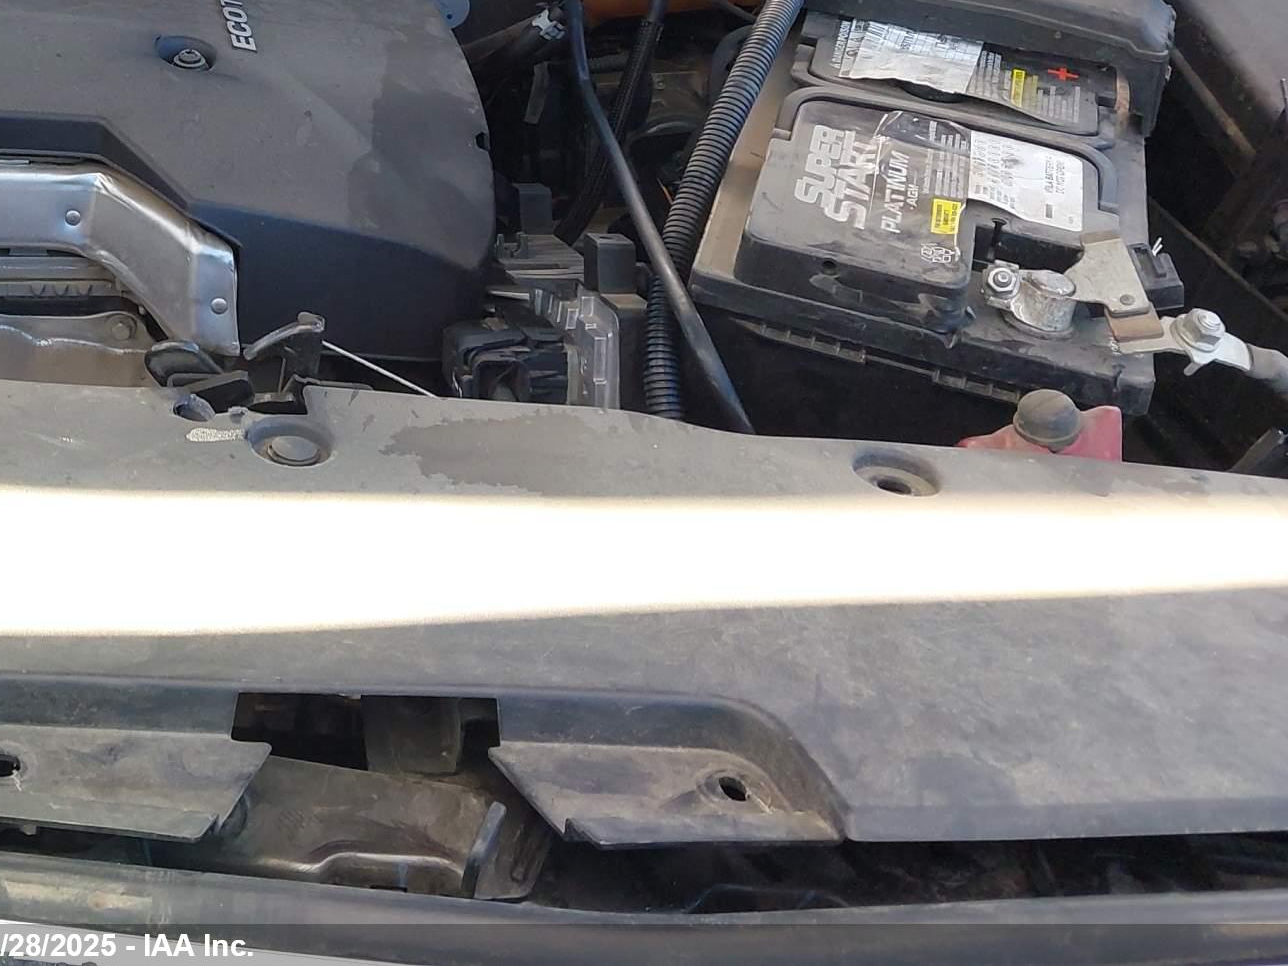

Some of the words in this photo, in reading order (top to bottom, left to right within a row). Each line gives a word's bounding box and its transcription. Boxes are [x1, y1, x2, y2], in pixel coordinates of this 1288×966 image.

[794, 124, 844, 209] SUPER
[823, 130, 878, 230] START
[880, 150, 911, 234] PLATINUM
